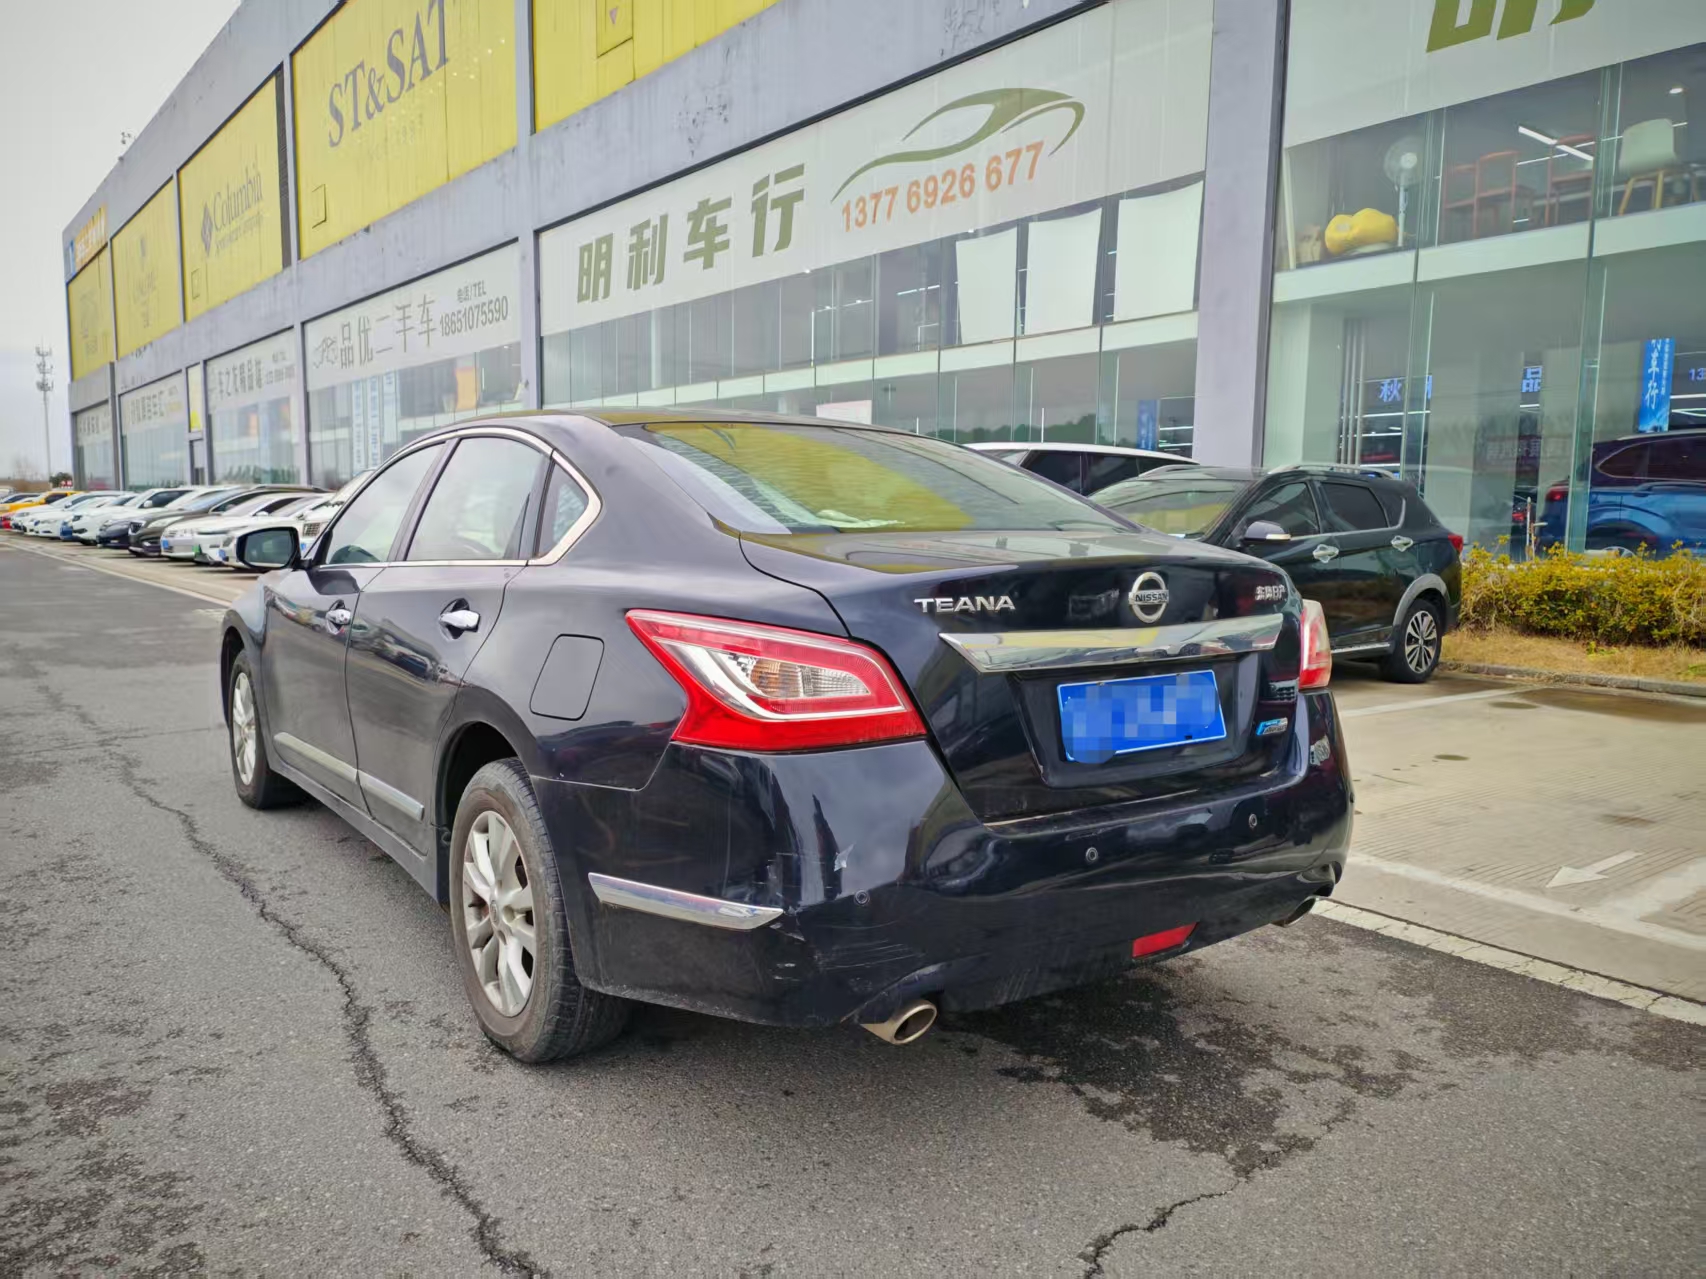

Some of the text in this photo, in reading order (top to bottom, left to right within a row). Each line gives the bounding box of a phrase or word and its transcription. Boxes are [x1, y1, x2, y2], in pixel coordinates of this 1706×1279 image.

[328, 0, 455, 148] ST&SAT
[214, 164, 263, 231] Columbia
[842, 142, 1045, 232] 1377 6926 677
[577, 163, 805, 303] 明利车行
[340, 294, 437, 369] 品优二手车
[439, 296, 508, 337] 18651075590
[1378, 379, 1402, 402] 秋
[913, 595, 1016, 613] TEANA
[1135, 592, 1168, 602] NISSAN
